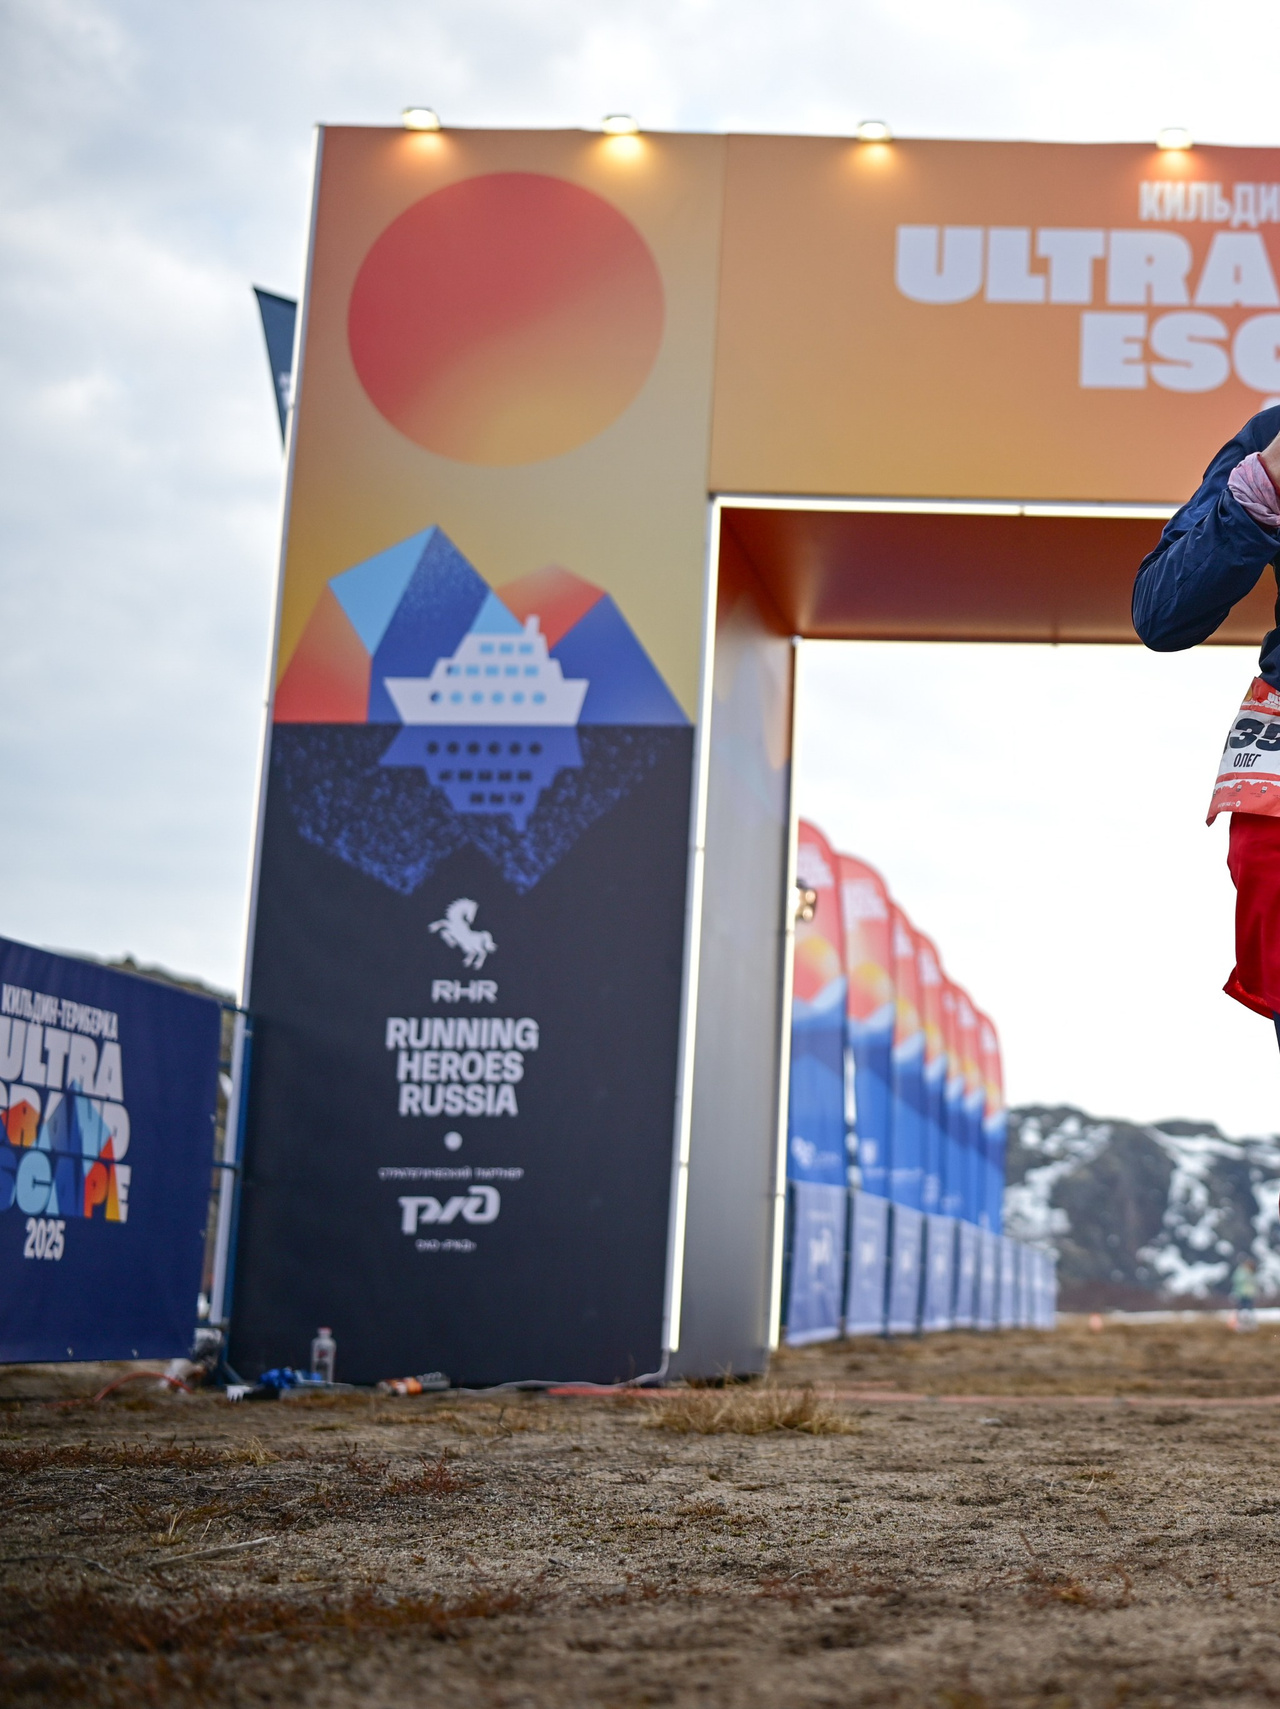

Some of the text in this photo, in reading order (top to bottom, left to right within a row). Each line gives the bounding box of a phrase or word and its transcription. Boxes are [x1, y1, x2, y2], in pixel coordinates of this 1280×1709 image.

[895, 225, 1280, 306] ULTRA
[1233, 752, 1262, 768] ОЛЕГ
[431, 980, 498, 1002] RHR
[385, 1017, 540, 1051] RUNNING
[396, 1051, 525, 1083] HEROES
[398, 1083, 519, 1117] RUSSIA
[0, 1079, 131, 1162] RAND
[24, 1217, 66, 1261] 2025
